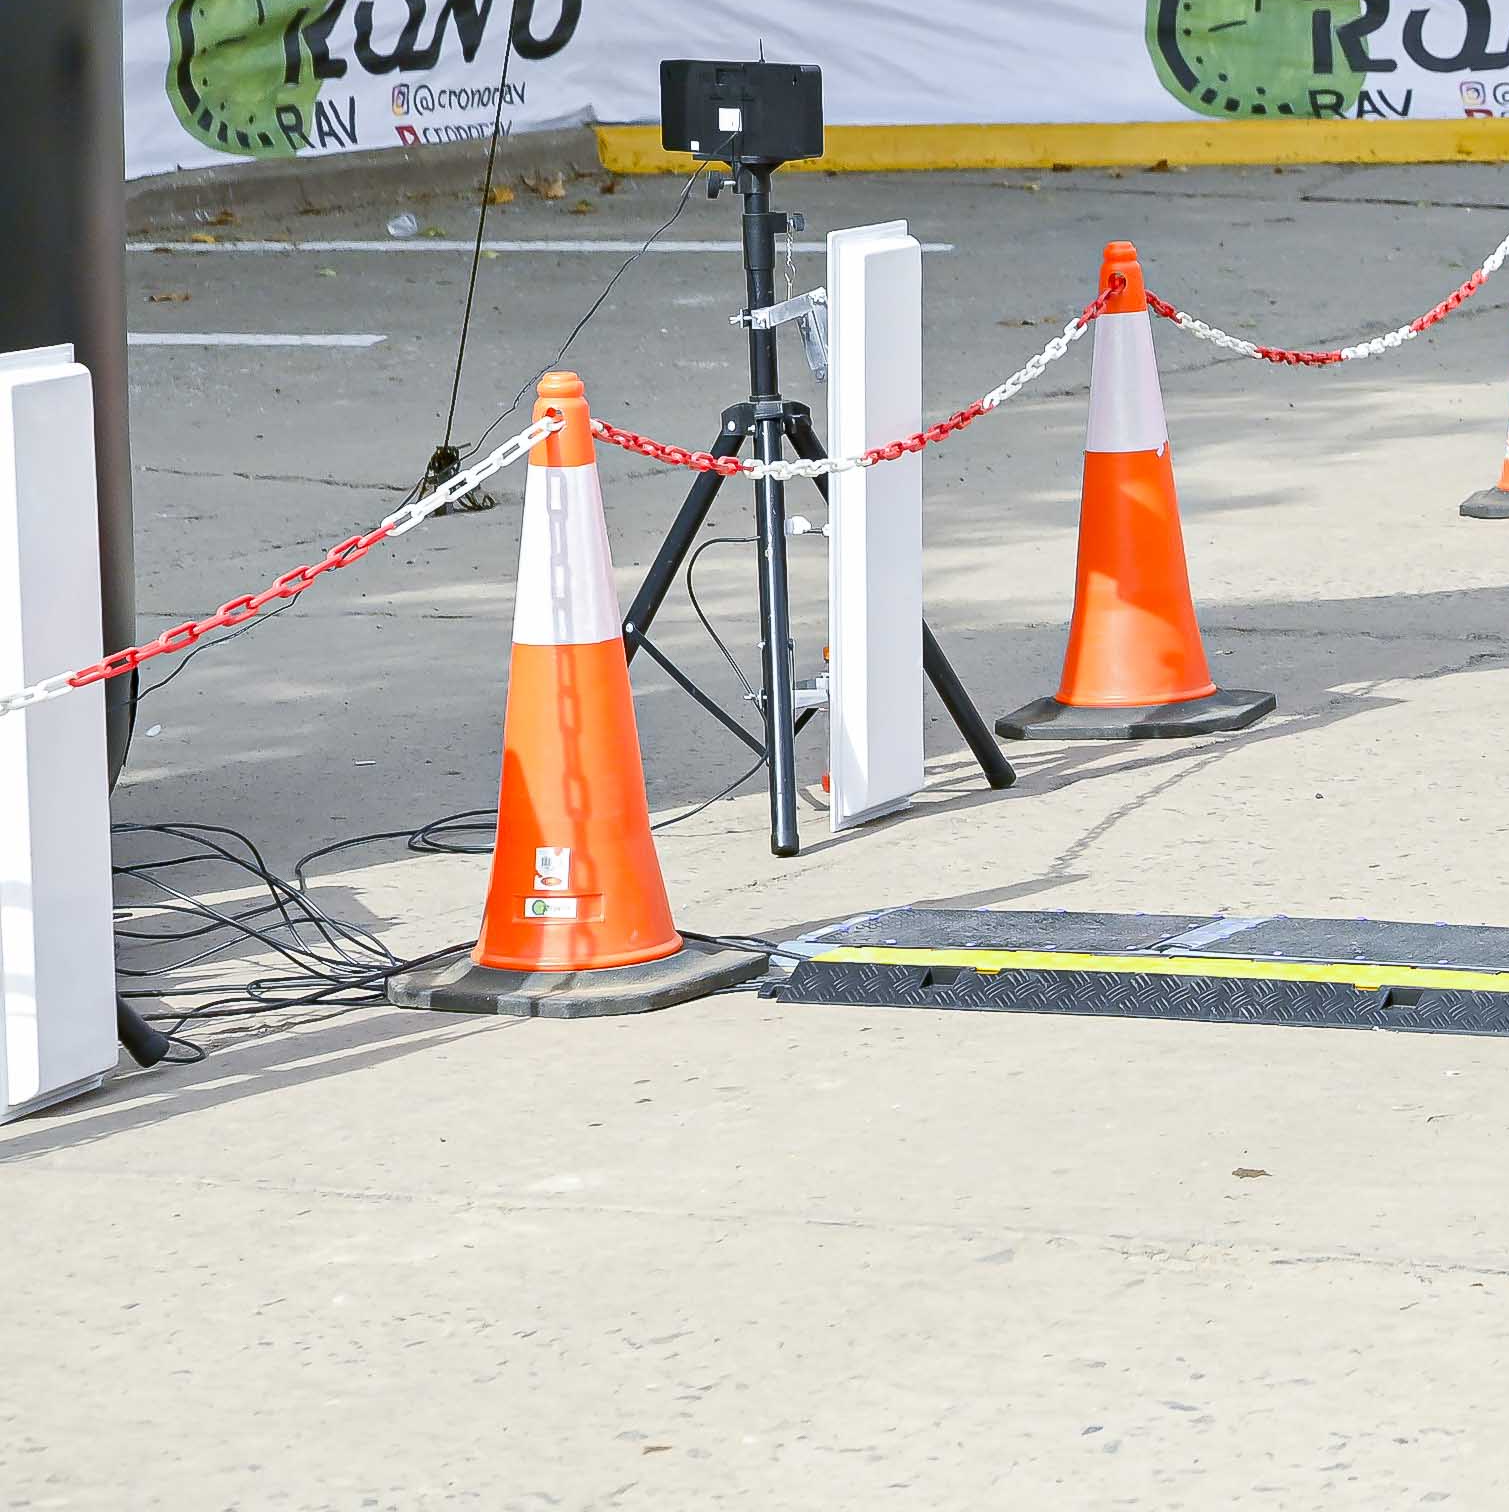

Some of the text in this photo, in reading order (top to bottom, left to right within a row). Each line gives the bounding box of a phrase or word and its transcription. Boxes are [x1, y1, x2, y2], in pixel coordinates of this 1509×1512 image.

[413, 82, 526, 116] @cronorav
[1308, 89, 1412, 119] RAV
[276, 95, 359, 151] RAV
